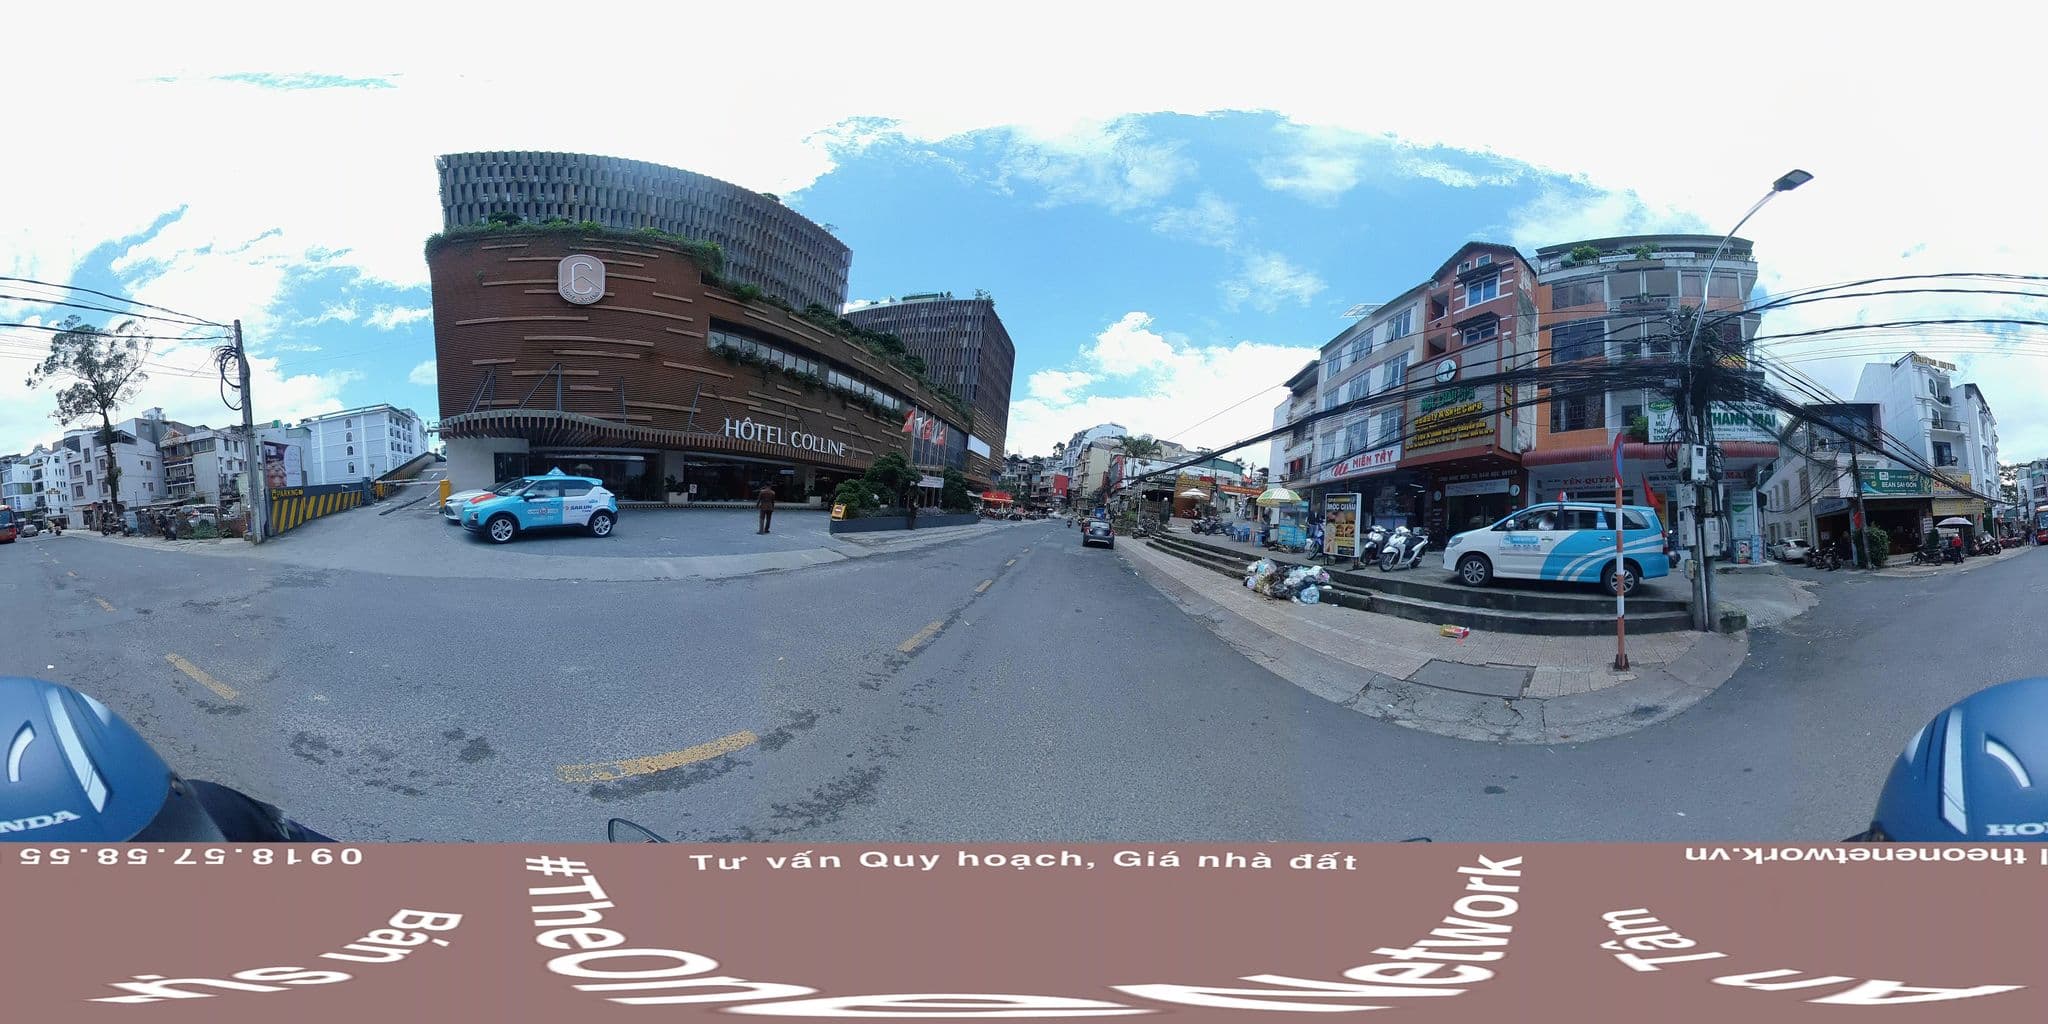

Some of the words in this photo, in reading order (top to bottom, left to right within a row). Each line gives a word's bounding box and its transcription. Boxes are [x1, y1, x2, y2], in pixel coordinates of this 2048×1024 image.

[724, 416, 787, 446] HÔTEL
[790, 431, 846, 458] COLLINE
[1986, 822, 2048, 836] HO
